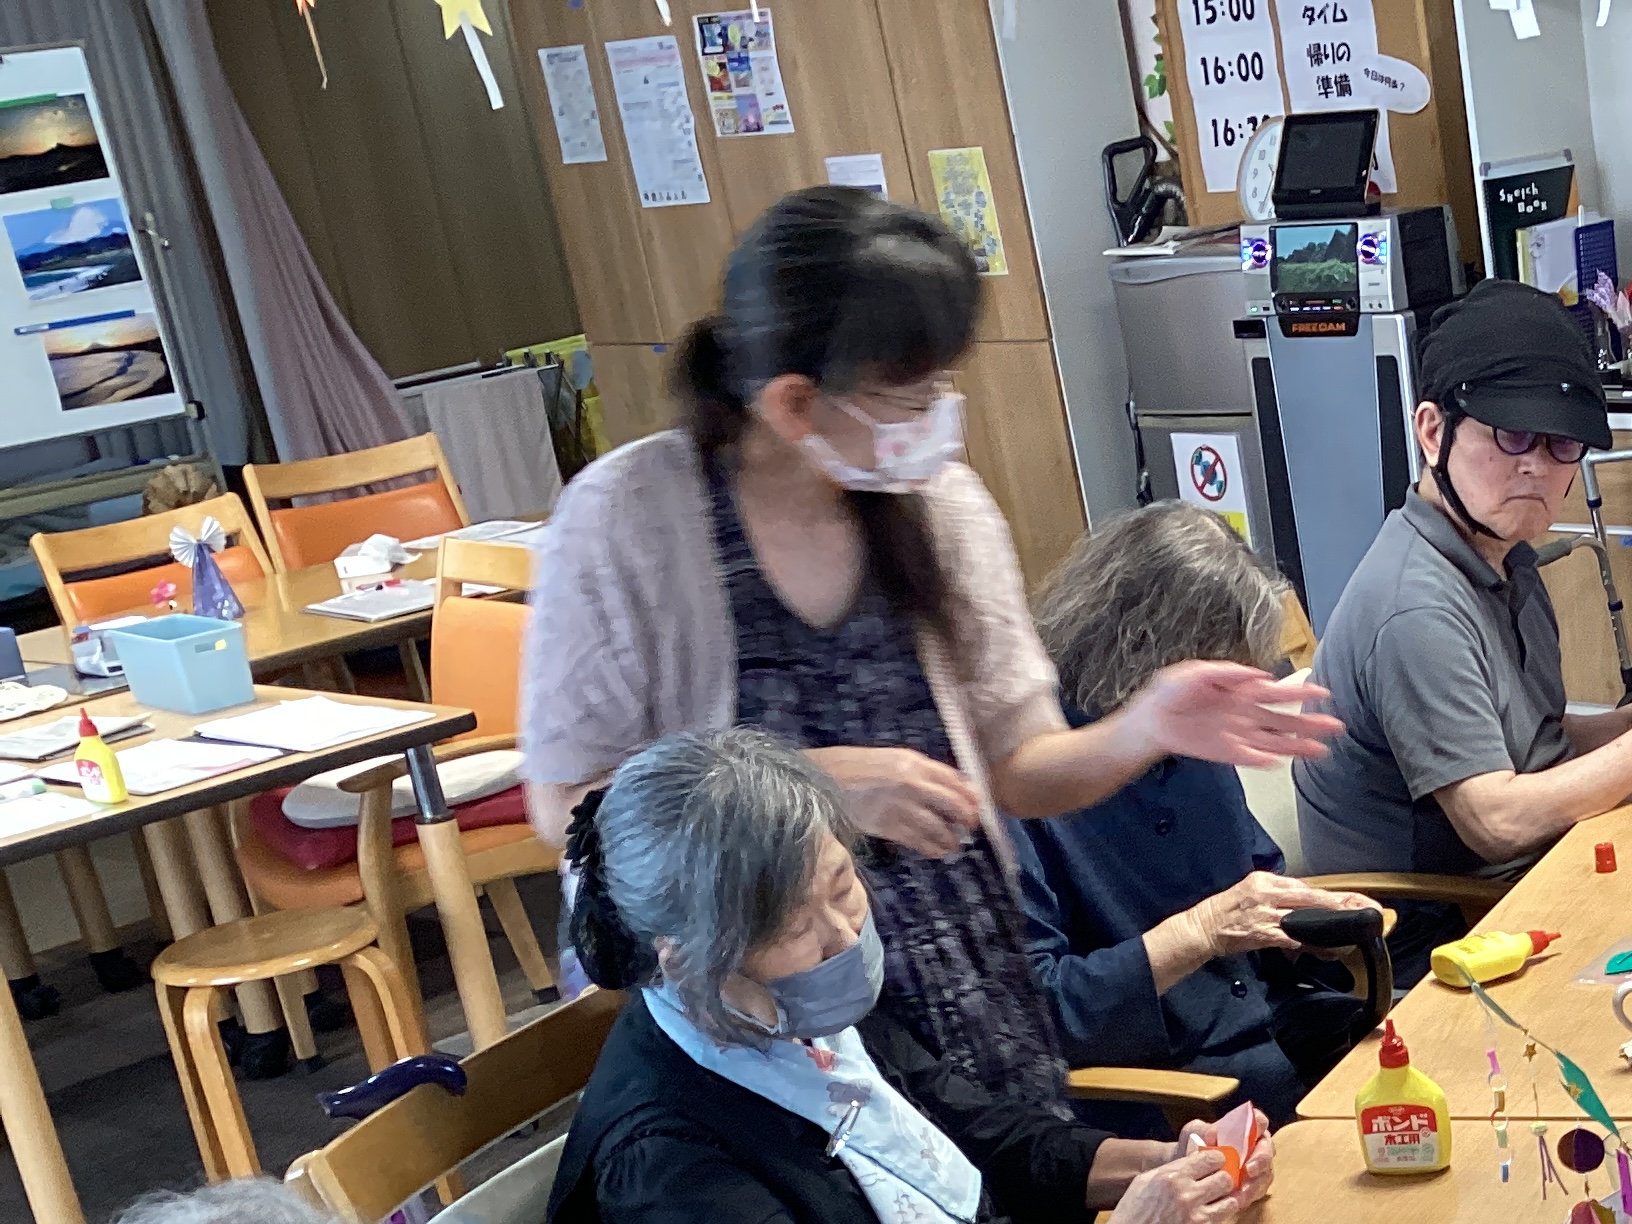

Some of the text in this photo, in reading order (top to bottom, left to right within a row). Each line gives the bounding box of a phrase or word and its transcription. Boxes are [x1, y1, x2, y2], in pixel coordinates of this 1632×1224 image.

[1192, 0, 1256, 26] 15:00
[1301, 3, 1348, 25] タイム
[1306, 42, 1352, 68] 帰りの
[1200, 51, 1264, 86] 16:00
[1316, 73, 1353, 99] 準備
[1371, 1112, 1429, 1133] ボンド
